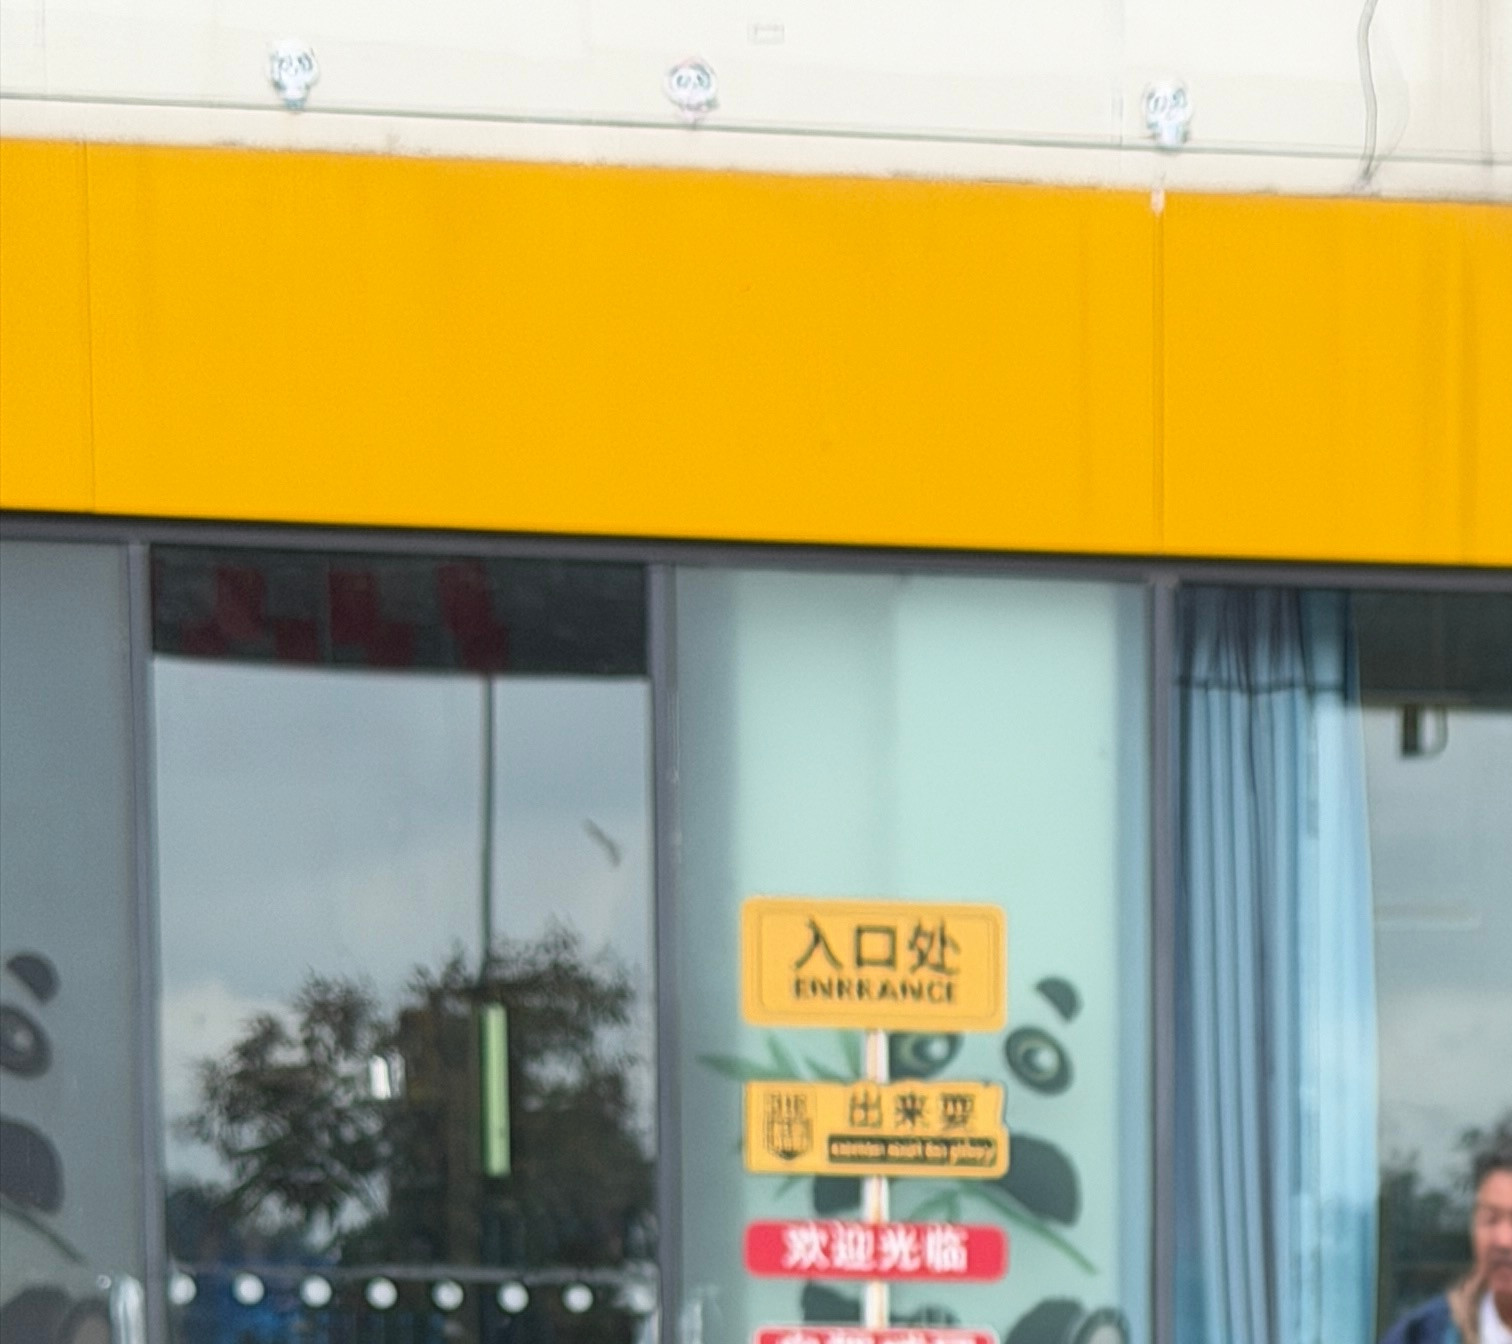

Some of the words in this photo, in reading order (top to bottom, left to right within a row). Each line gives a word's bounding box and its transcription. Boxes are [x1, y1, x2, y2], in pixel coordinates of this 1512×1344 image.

[791, 916, 961, 976] 入口处
[782, 1222, 969, 1273] 欢迎光临
